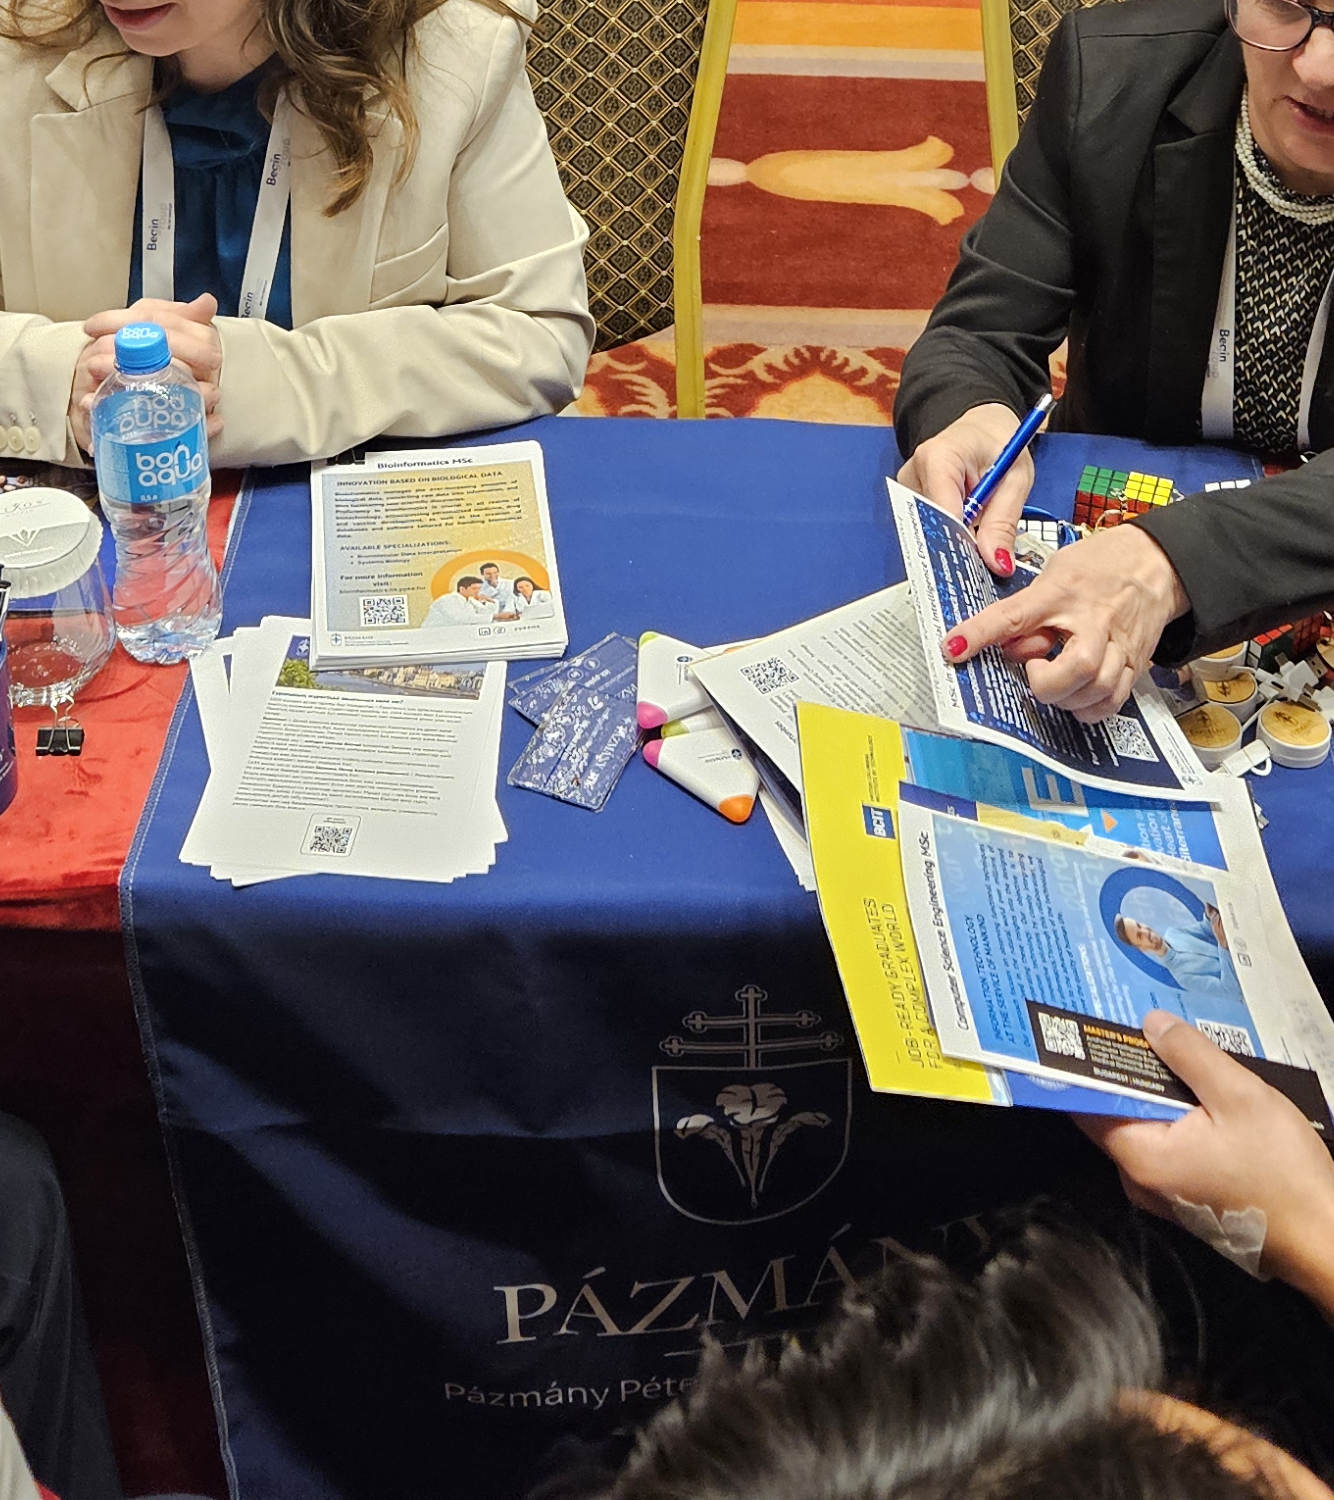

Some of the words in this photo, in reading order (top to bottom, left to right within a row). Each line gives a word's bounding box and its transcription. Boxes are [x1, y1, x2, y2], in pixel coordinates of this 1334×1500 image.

[138, 453, 203, 486] aqua
[336, 477, 387, 488] INNOVATION
[389, 476, 416, 484] BASED
[431, 472, 478, 481] BIOLOGICAL
[480, 470, 503, 478] DATA
[377, 457, 449, 470] Bioinformatics
[452, 456, 474, 464] MSc
[339, 543, 381, 552] AVAILABLE
[382, 539, 452, 550] SPECIALIZATIONS:
[904, 498, 927, 559] Engineering
[376, 570, 423, 579] information
[918, 560, 940, 624] Intelligence
[944, 672, 953, 683] in
[946, 683, 961, 709] MSc
[869, 805, 887, 838] BCIT
[916, 829, 933, 858] MSc
[976, 842, 992, 882] techniques
[995, 846, 1010, 881] designed
[1016, 850, 1032, 892] integrating
[920, 858, 947, 929] Engineering
[1010, 873, 1025, 907] objective
[1035, 855, 1052, 905] technological
[984, 882, 998, 920] functional
[997, 904, 1009, 927] world
[1018, 909, 1028, 925] Our
[1024, 892, 1036, 919] closely
[861, 894, 899, 981] GRADUATES
[879, 900, 906, 954] WORLD
[962, 912, 986, 973] TECHNOLOGY
[975, 912, 994, 957] MANKIND
[993, 920, 1007, 956] observing
[1010, 914, 1023, 941] insights
[935, 929, 955, 973] Science
[985, 956, 997, 971] OF
[895, 952, 929, 1028] COMPLEX
[947, 972, 971, 1031] Computer
[988, 970, 1008, 1010] SERVICE
[886, 978, 925, 1070] JOB-READY
[978, 976, 1004, 1042] INFORMATION
[998, 1009, 1012, 1030] THE
[1012, 997, 1027, 1032] approach
[923, 1026, 935, 1037] A
[1003, 1028, 1017, 1045] AT
[922, 1037, 943, 1070] FOR
[444, 1380, 610, 1411] Pázmány
